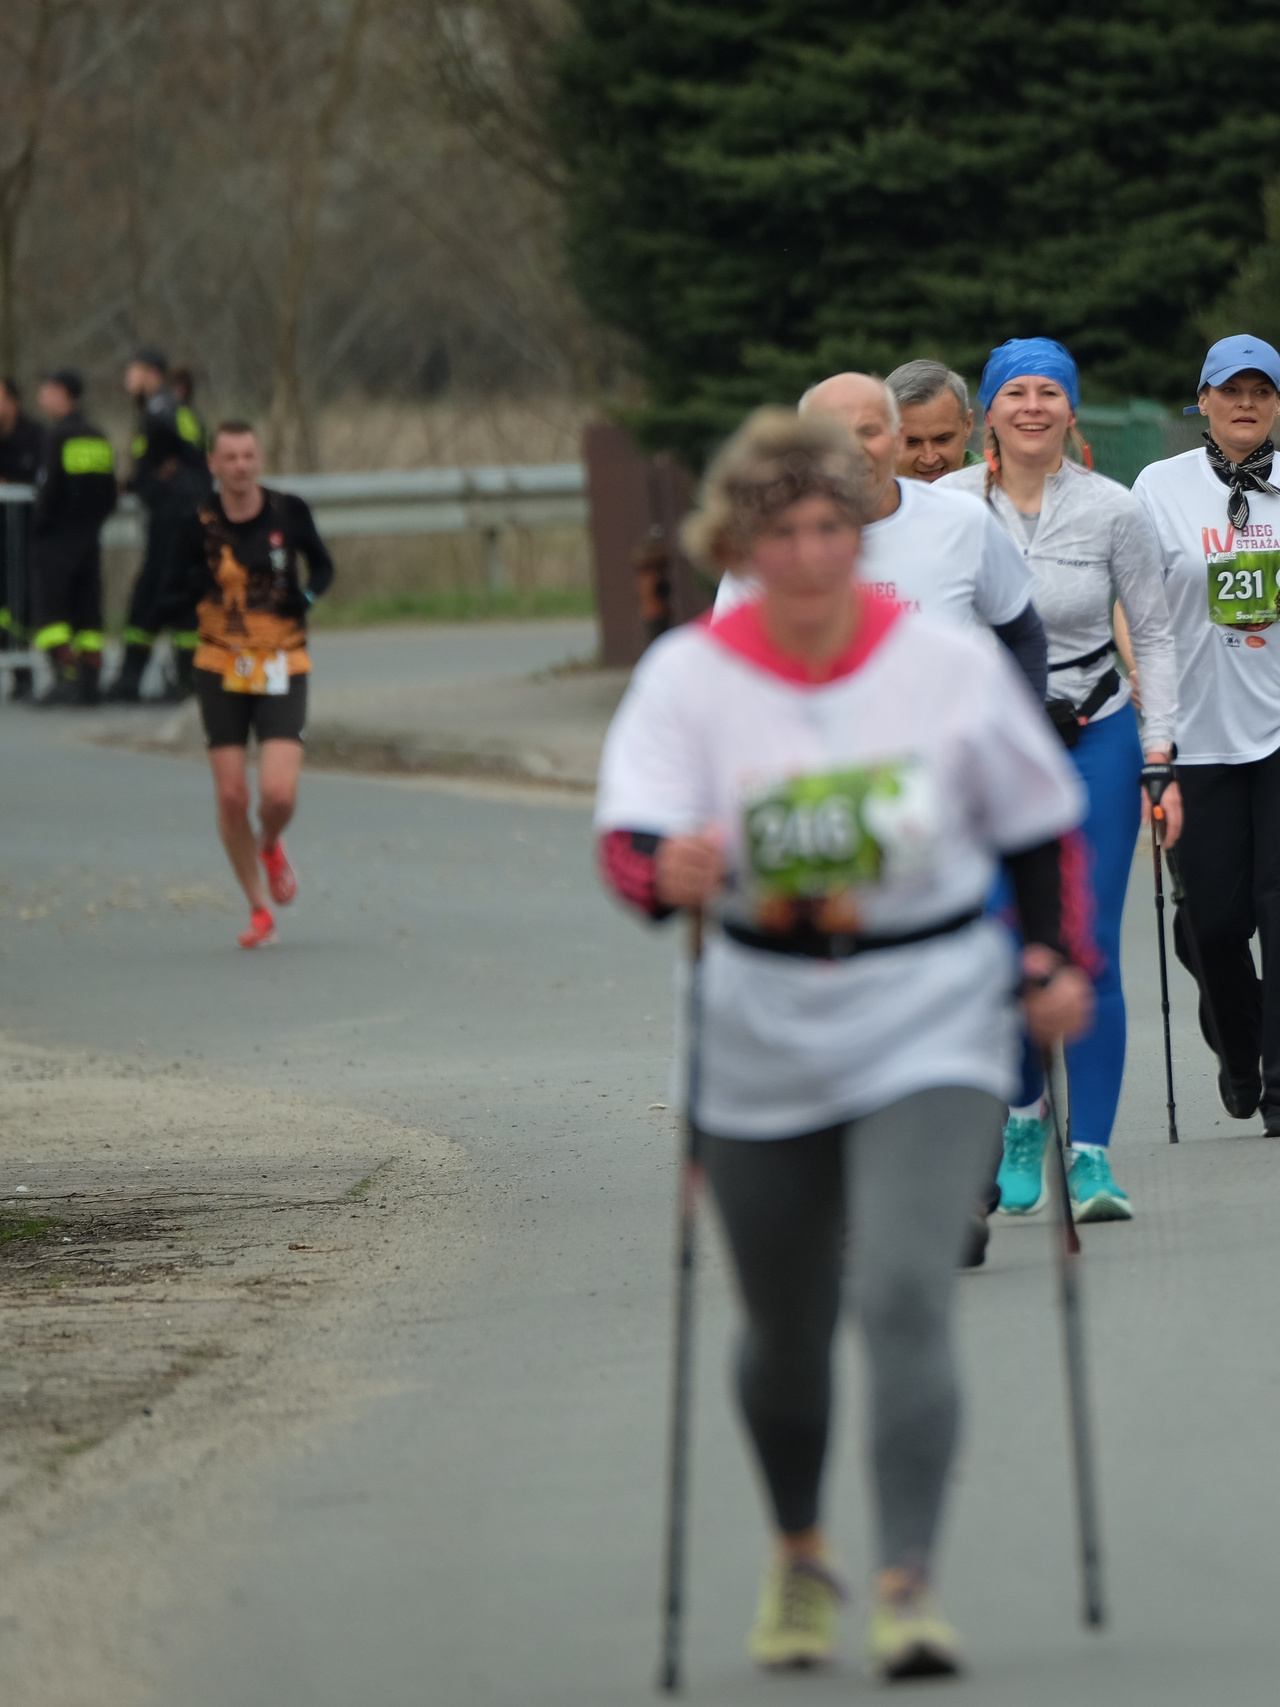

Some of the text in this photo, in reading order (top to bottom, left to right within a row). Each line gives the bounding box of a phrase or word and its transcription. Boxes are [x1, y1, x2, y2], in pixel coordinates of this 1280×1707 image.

[1201, 522, 1273, 556] IV BIEG
[1217, 569, 1263, 600] 231
[750, 795, 861, 870] 246
